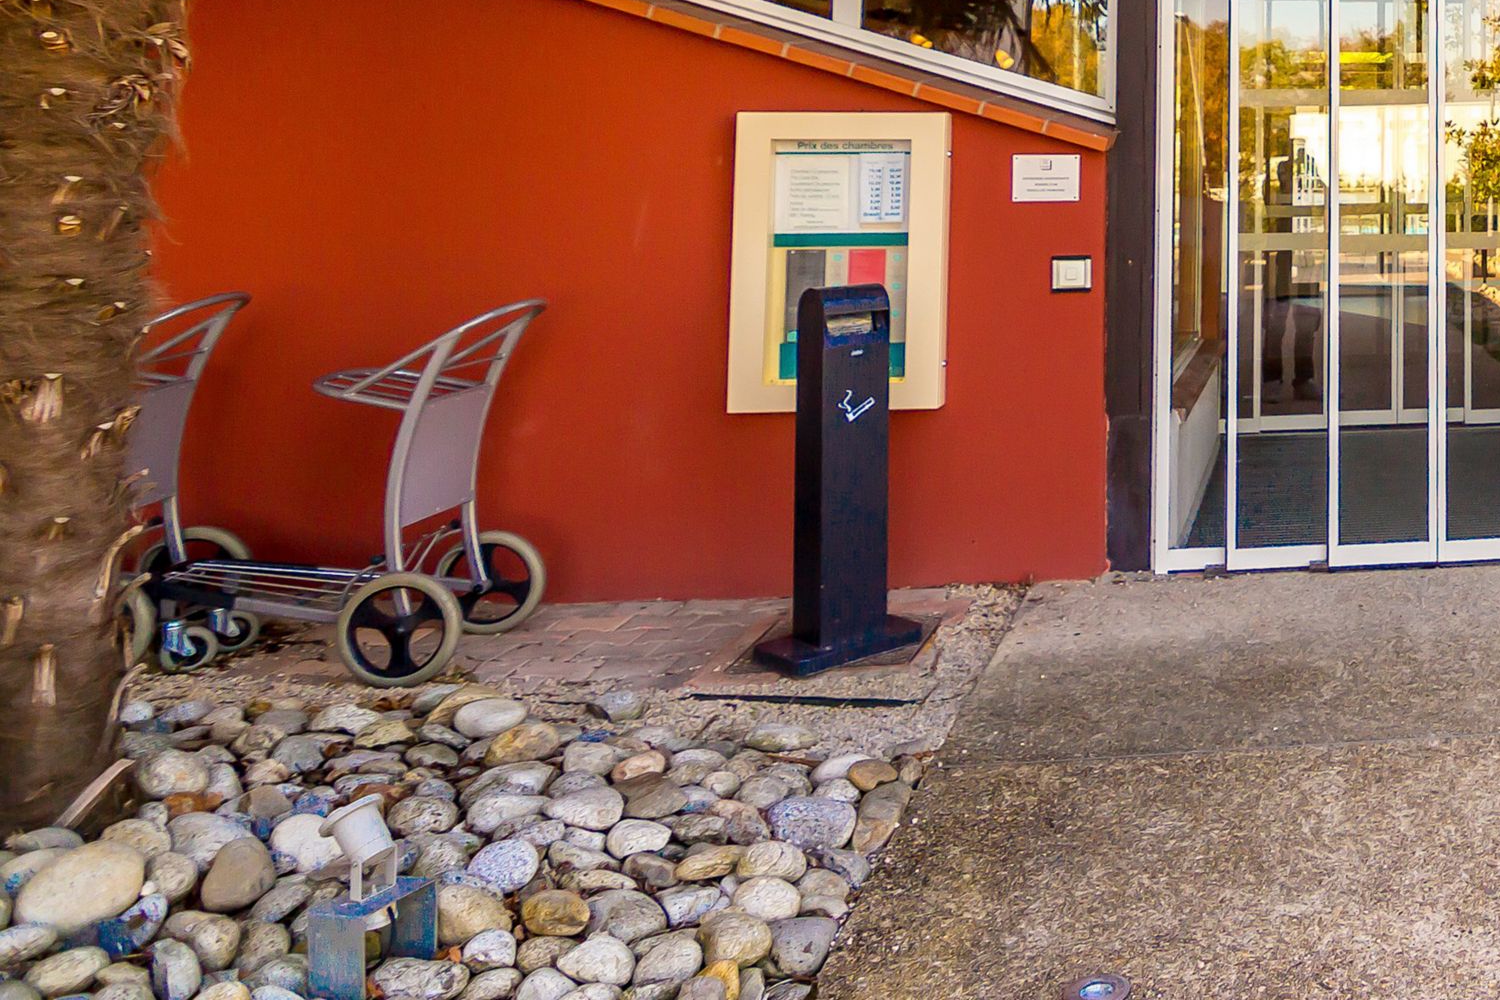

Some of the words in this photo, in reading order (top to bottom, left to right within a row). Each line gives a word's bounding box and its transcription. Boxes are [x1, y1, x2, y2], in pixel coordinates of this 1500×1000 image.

[797, 141, 817, 150] Prix
[820, 141, 839, 150] des
[842, 141, 894, 150] chambres
